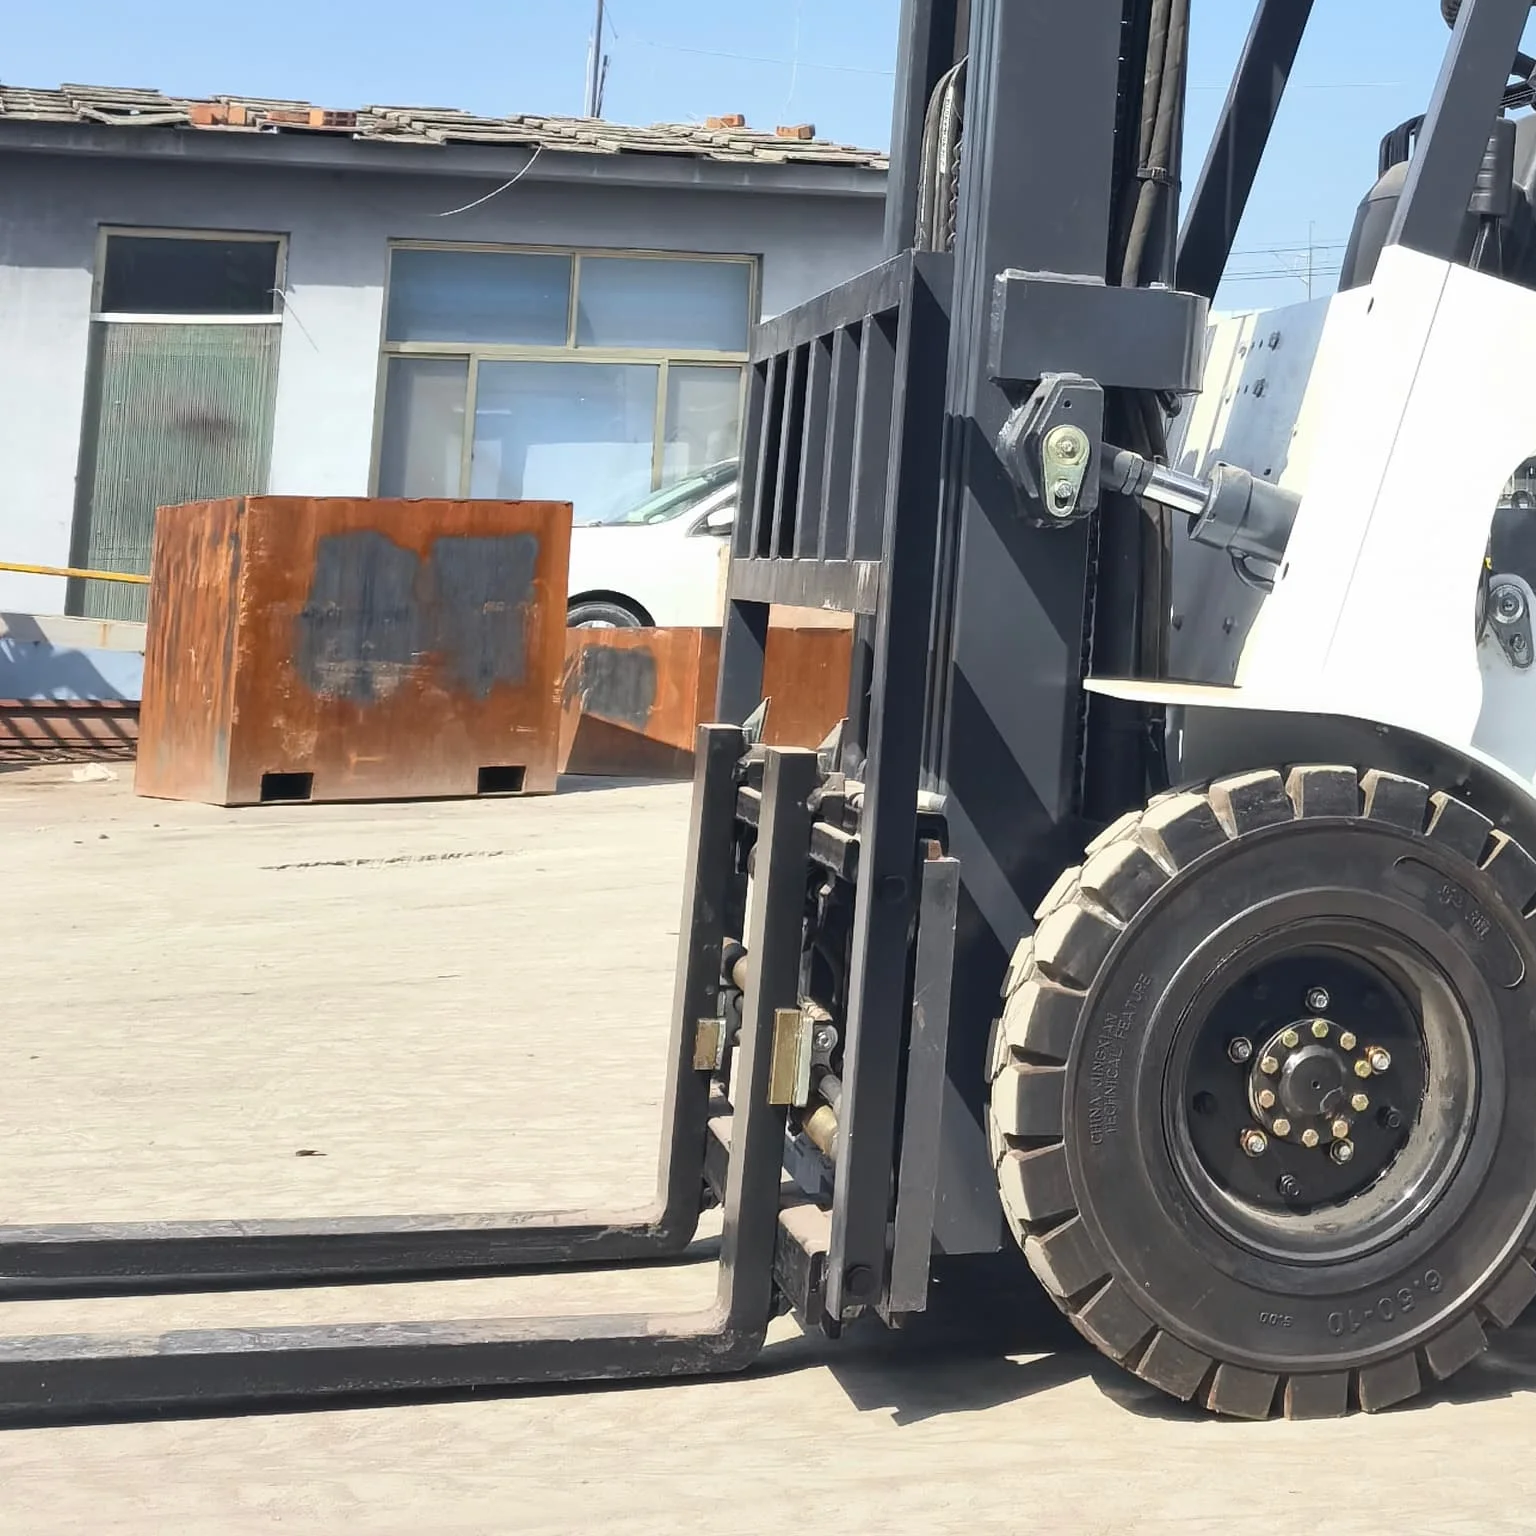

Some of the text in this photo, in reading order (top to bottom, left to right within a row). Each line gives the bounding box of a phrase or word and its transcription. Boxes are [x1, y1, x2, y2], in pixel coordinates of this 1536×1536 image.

[1104, 973, 1151, 1134] TECHNICAL FEATURE
[1089, 1097, 1103, 1145] CHINA
[1328, 1269, 1442, 1336] 6.50-10
